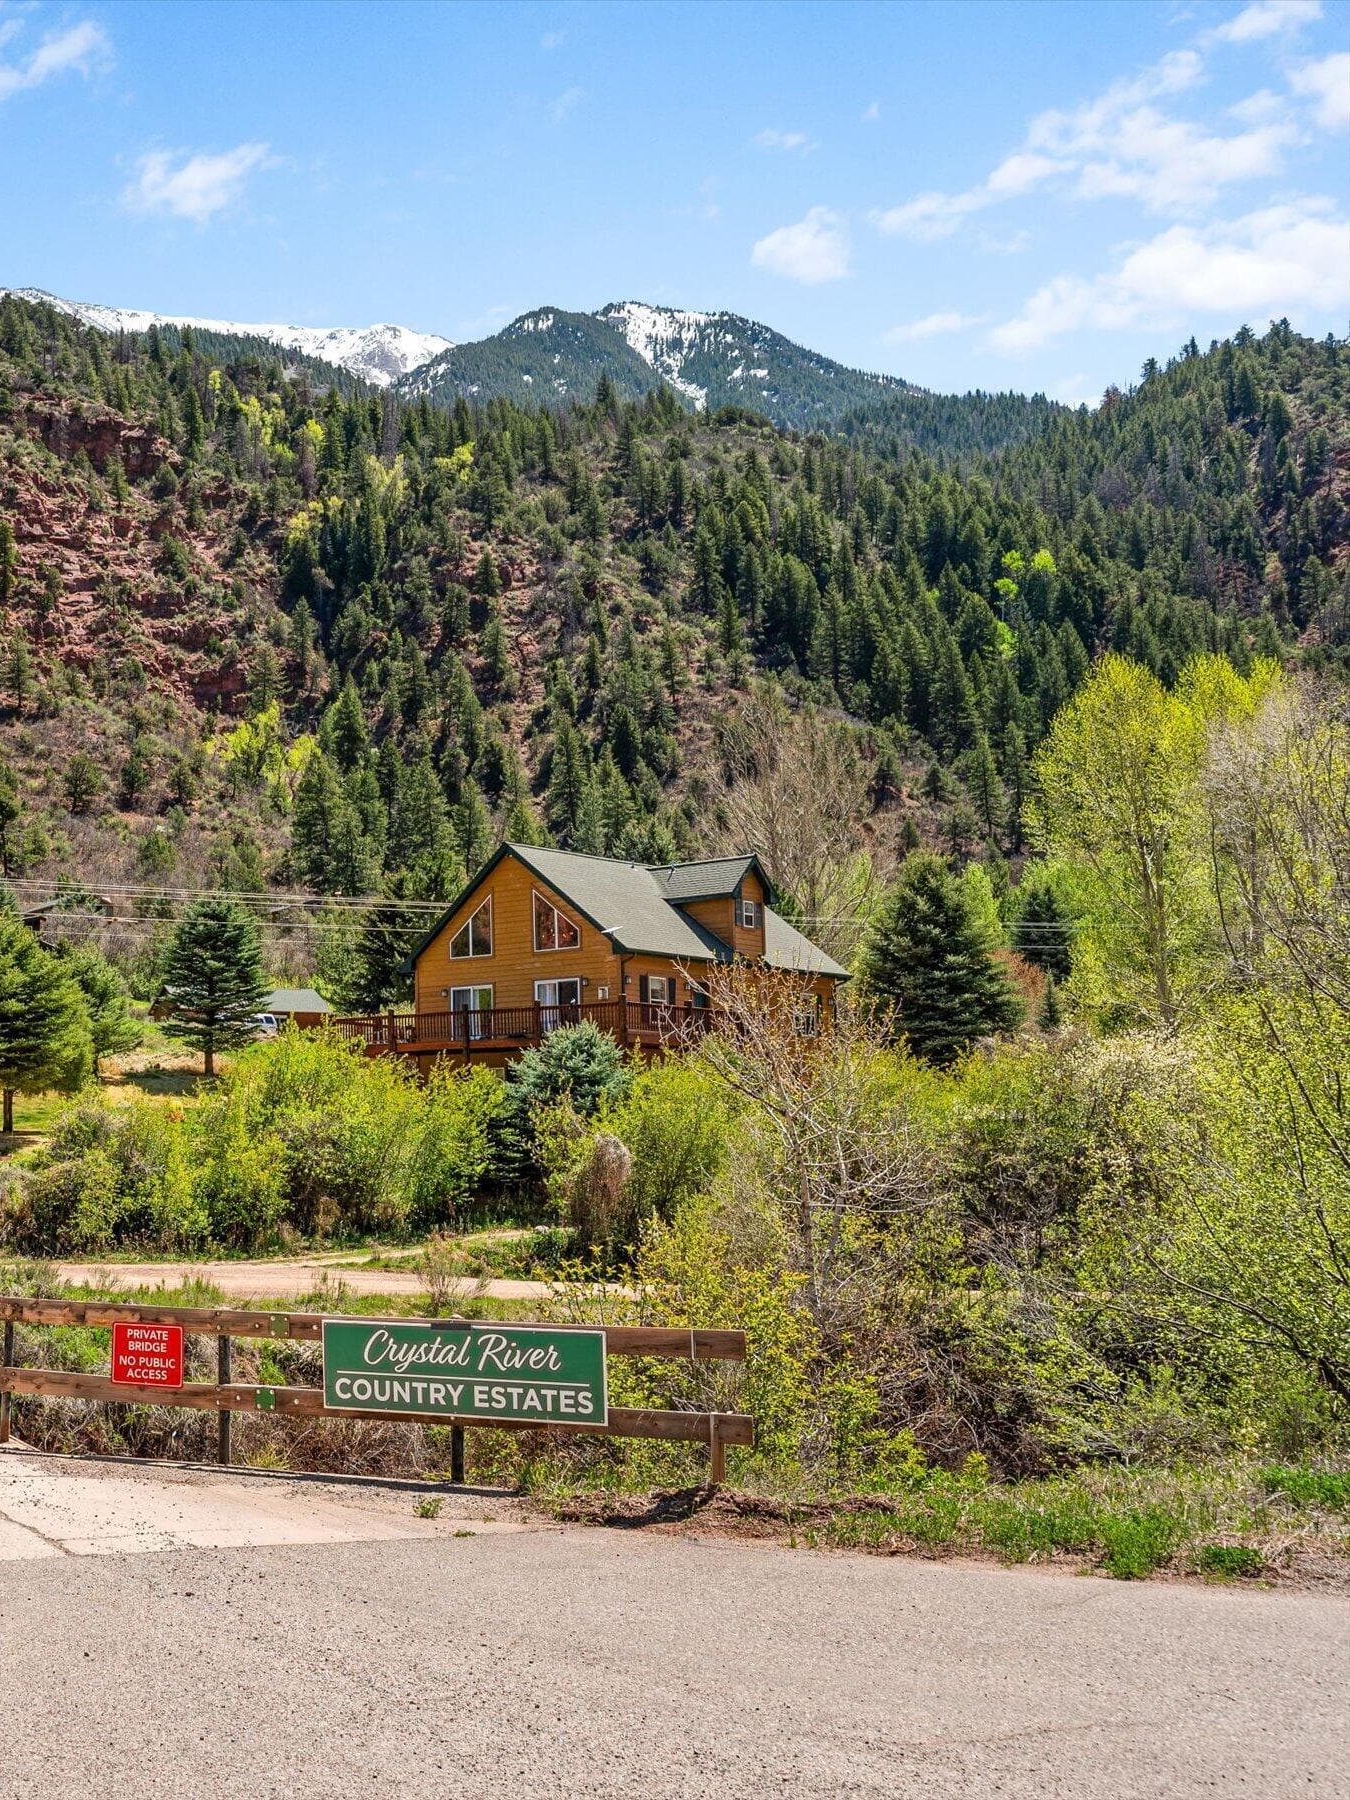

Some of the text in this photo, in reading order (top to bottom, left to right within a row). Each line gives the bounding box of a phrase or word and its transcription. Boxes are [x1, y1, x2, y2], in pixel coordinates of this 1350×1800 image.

[125, 1328, 169, 1341] PRIVATE
[128, 1341, 167, 1353] BRIDGE
[363, 1329, 562, 1373] Crystal River
[119, 1355, 176, 1369] NO PUBLIC
[126, 1368, 168, 1381] ACCESS
[335, 1377, 595, 1415] COUNTRY ESTATES
